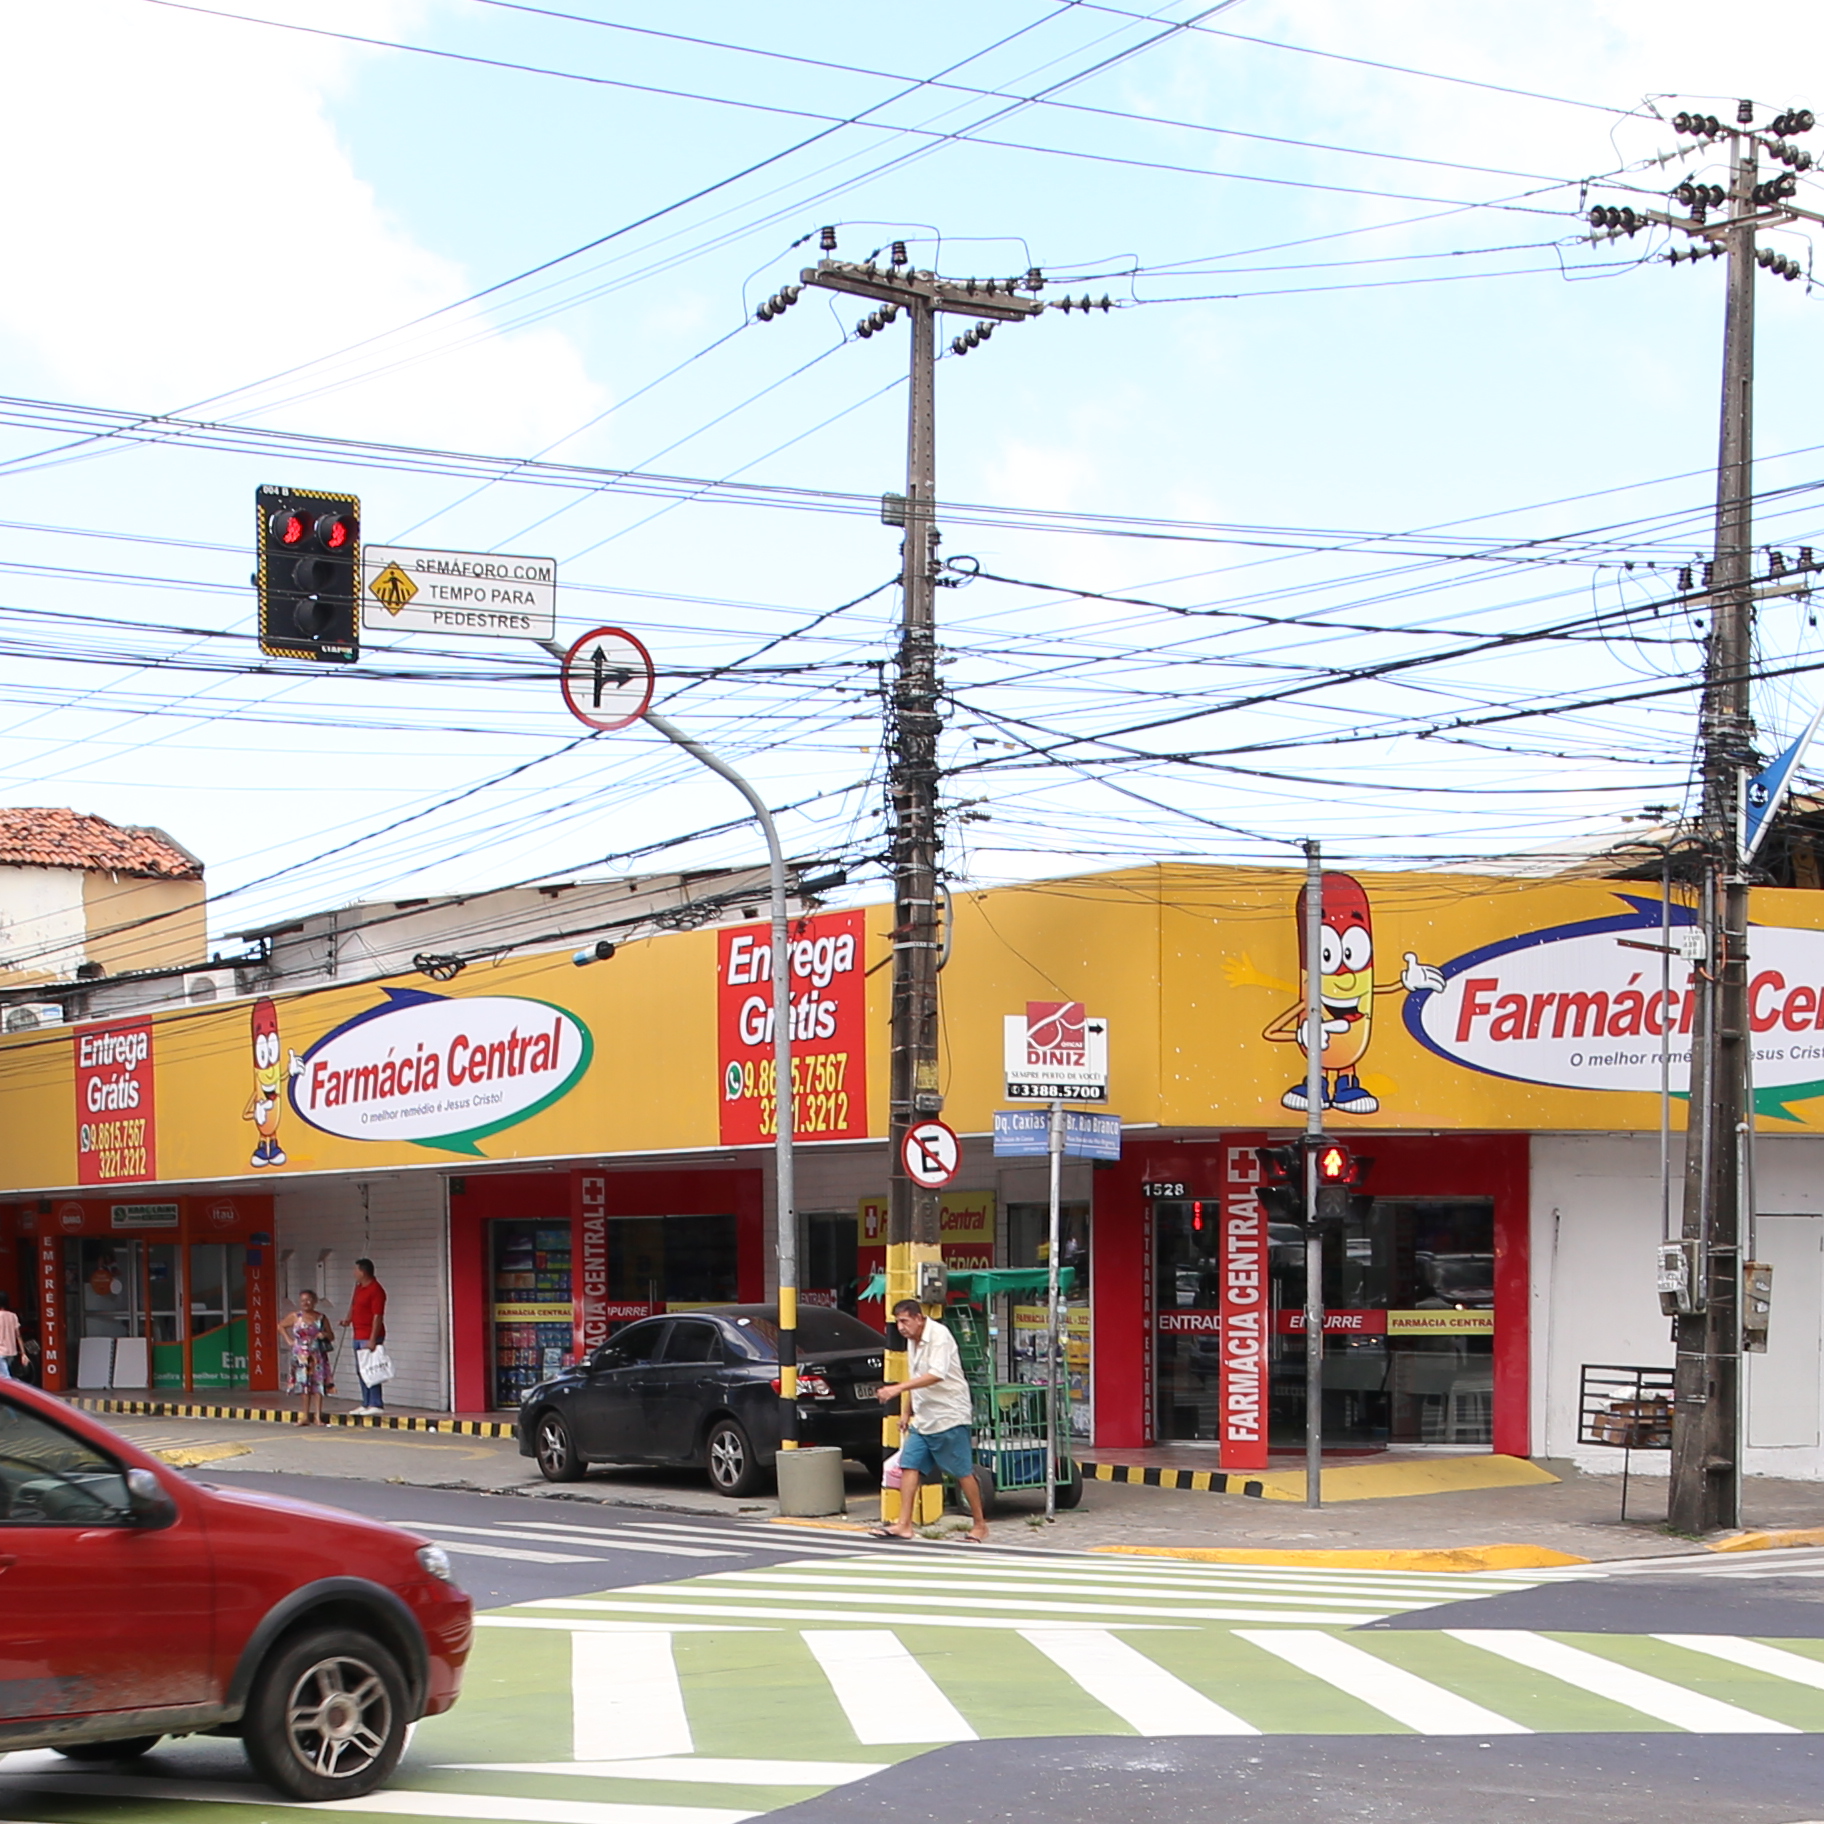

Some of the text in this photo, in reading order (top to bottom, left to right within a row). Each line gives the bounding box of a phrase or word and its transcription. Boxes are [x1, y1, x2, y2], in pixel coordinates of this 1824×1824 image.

[416, 558, 551, 581] SEMÁFORO COM
[430, 585, 536, 605] TEMPO PARA
[434, 612, 530, 630] PEDESTRES
[727, 933, 855, 988] Enrega
[1455, 972, 1696, 1043] Farmáci
[80, 1032, 148, 1071] Entrega
[309, 1016, 562, 1110] Farmácia Central
[1028, 1051, 1085, 1066] DINIZ
[1570, 1053, 1583, 1067] O
[1588, 1051, 1647, 1066] melhor
[1012, 1071, 1039, 1079] SEMPRE
[87, 1072, 140, 1113] Grátis
[1021, 1085, 1100, 1097] 3388.5700
[361, 1091, 503, 1124] O melhor remédio é Jesus Cristo!
[90, 1119, 146, 1151] 9.8615.7567
[995, 1114, 1045, 1134] Dq. Caxias
[1066, 1115, 1119, 1136] Br. Rio Branco
[99, 1147, 147, 1178] 3221.3212
[1143, 1184, 1184, 1196] 1528
[940, 1205, 986, 1231] Central
[584, 1207, 606, 1296] CENTRAL
[801, 1293, 830, 1305] ENTRADA
[1225, 1186, 1259, 1441] FARMÁCIA CENTRAL
[1392, 1319, 1446, 1327] FARMÁCIA
